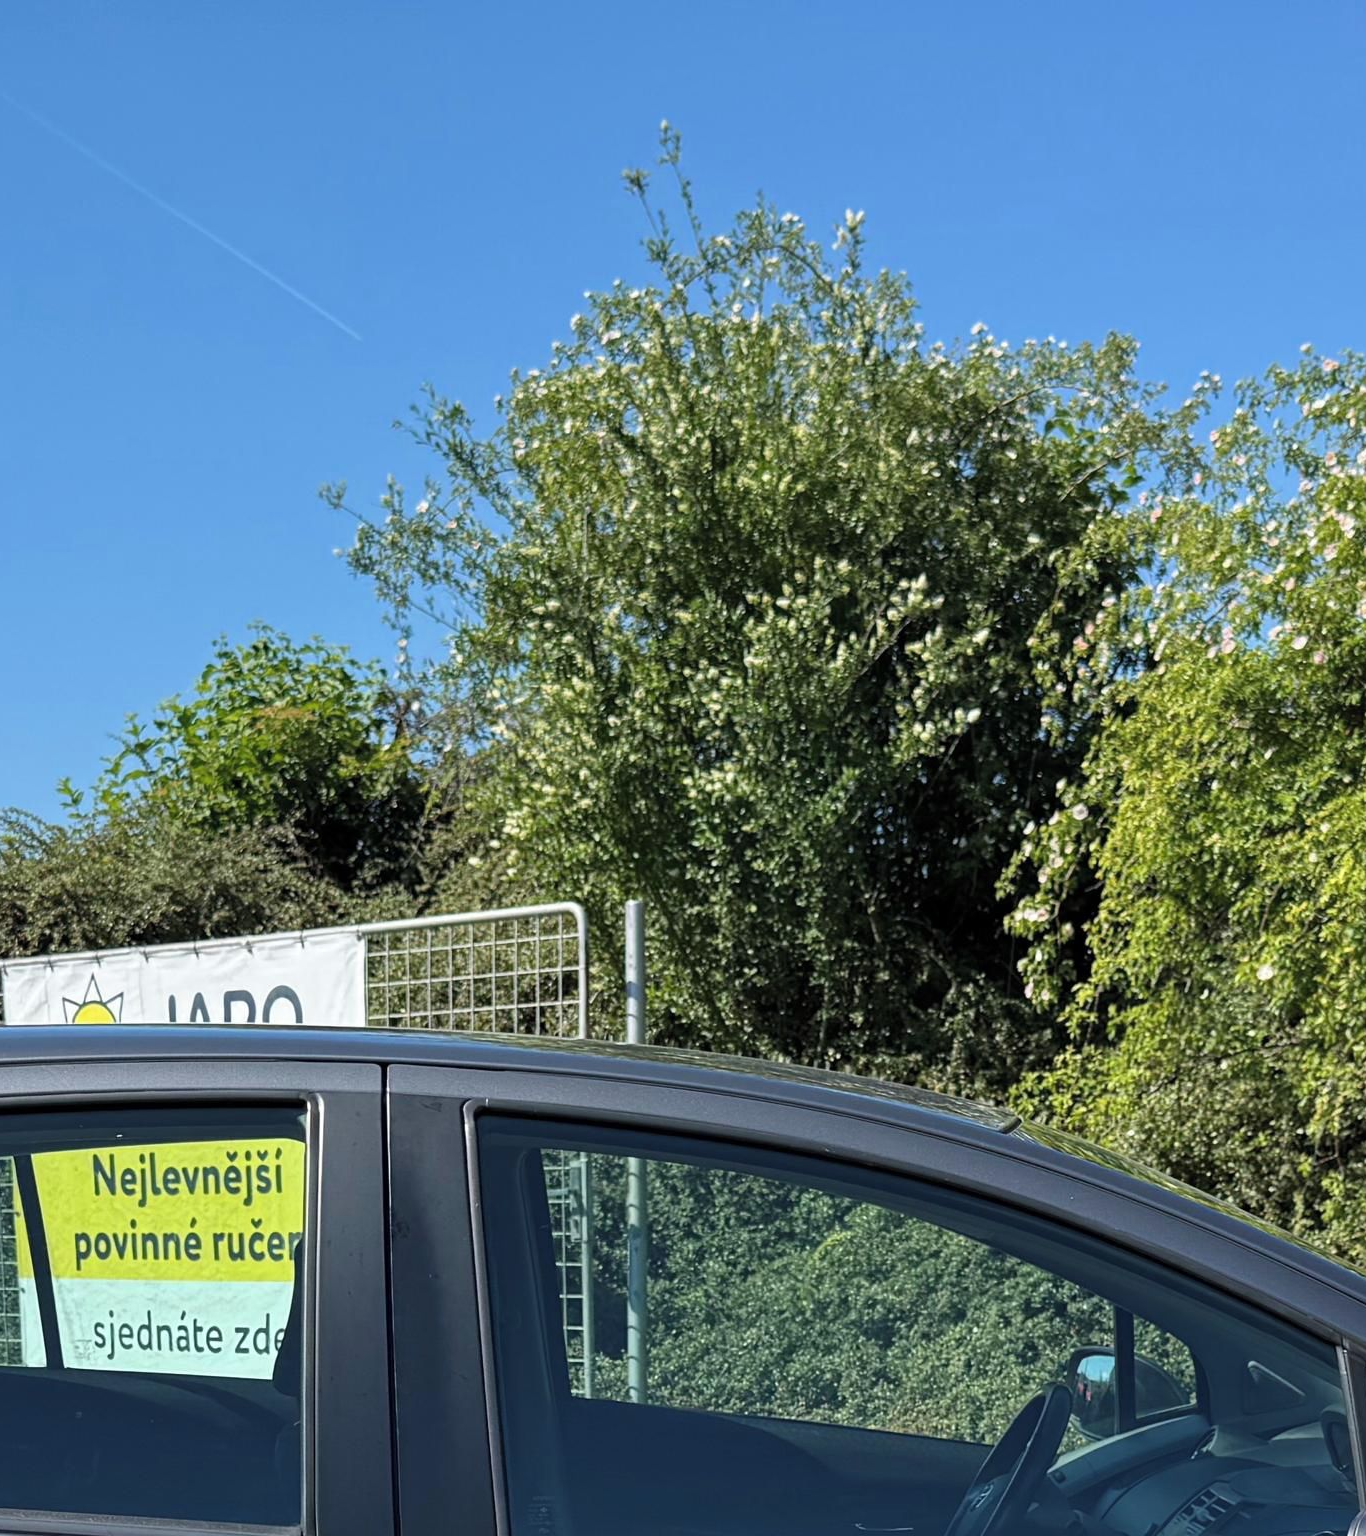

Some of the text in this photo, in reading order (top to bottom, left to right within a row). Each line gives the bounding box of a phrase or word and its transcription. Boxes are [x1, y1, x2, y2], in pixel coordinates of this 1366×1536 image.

[92, 1147, 283, 1208] Nejlevnější
[74, 1217, 202, 1271] povinné
[93, 1310, 286, 1360] sjednáte zde
